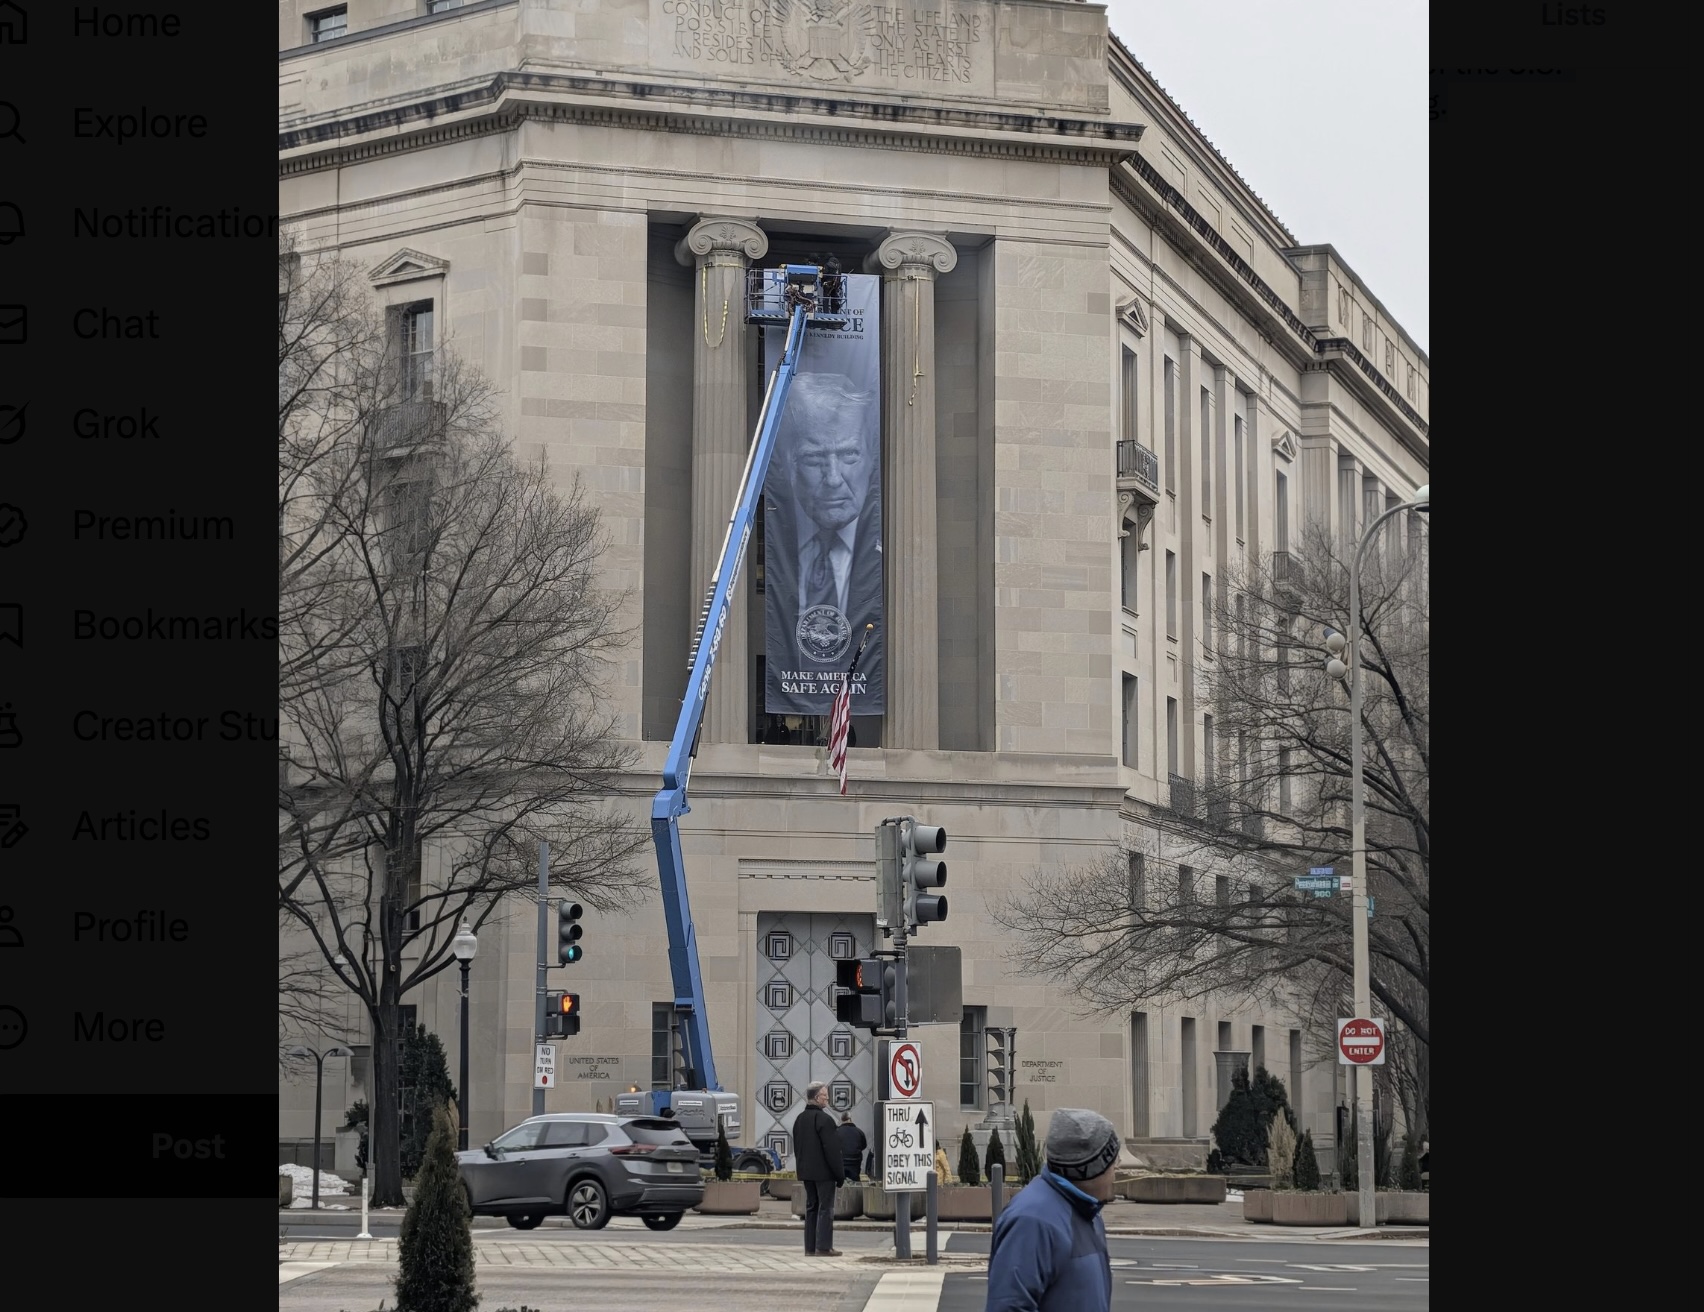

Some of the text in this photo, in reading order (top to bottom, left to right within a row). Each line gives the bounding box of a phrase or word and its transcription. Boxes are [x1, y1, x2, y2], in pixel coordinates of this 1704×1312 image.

[662, 1, 744, 20] CONDUCT
[750, 9, 771, 24] OF
[878, 21, 905, 36] THE
[915, 24, 958, 41] STATE
[967, 28, 980, 42] IS
[873, 6, 981, 28] THE LIFE AND
[676, 16, 972, 55] POSSIBLE ONLY AS FIRST
[693, 32, 753, 50] RESIDES
[760, 38, 773, 52] IN
[877, 48, 905, 63] THE
[915, 52, 972, 69] HEARTS
[672, 45, 701, 59] AND
[707, 47, 754, 64] SOULS
[761, 53, 779, 67] OF
[872, 61, 898, 77] THE
[781, 671, 867, 682] MAKE AMERCA
[781, 682, 867, 695] SAFE AGIN
[1345, 1027, 1377, 1035] DO NOT
[541, 1047, 550, 1055] NO
[1349, 1047, 1375, 1056] ENTER
[569, 1057, 619, 1065] UNITED STATES
[887, 1106, 910, 1121] THRU
[887, 1153, 932, 1168] OBEY THIS
[887, 1170, 918, 1185] SIGNAL
